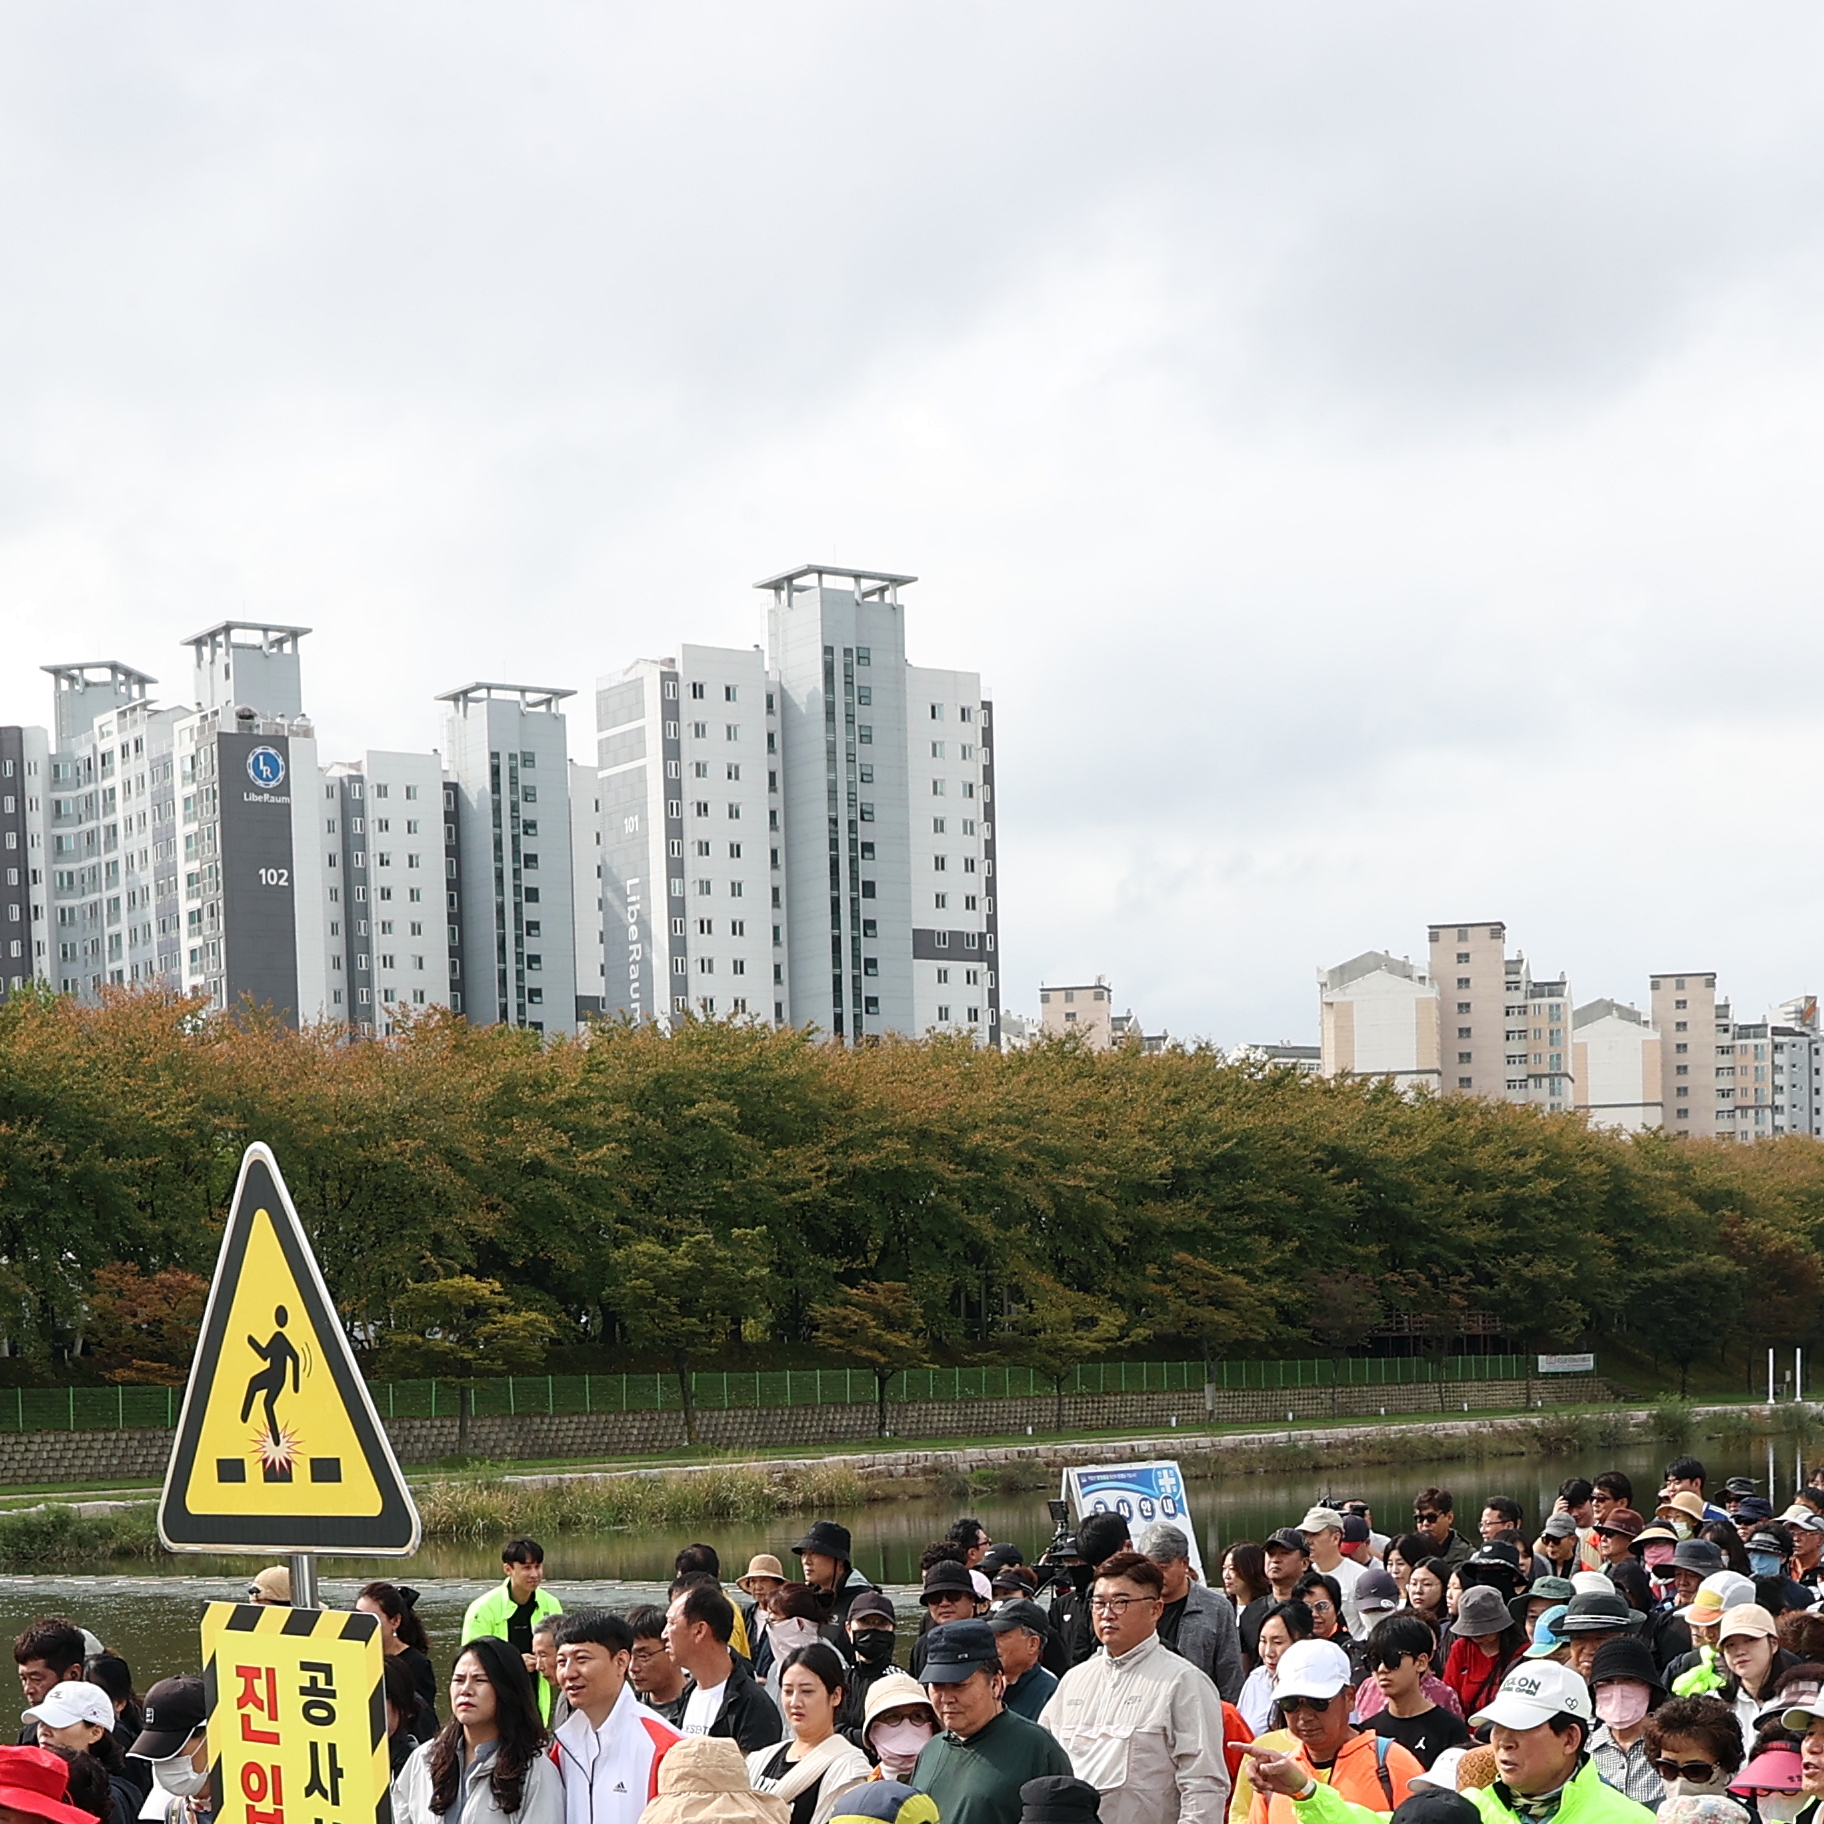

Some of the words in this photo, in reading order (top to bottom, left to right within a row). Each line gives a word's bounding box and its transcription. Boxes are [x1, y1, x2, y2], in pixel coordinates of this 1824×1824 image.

[243, 792, 290, 804] LibeRaum
[624, 815, 639, 834] 101
[258, 868, 289, 887] 102
